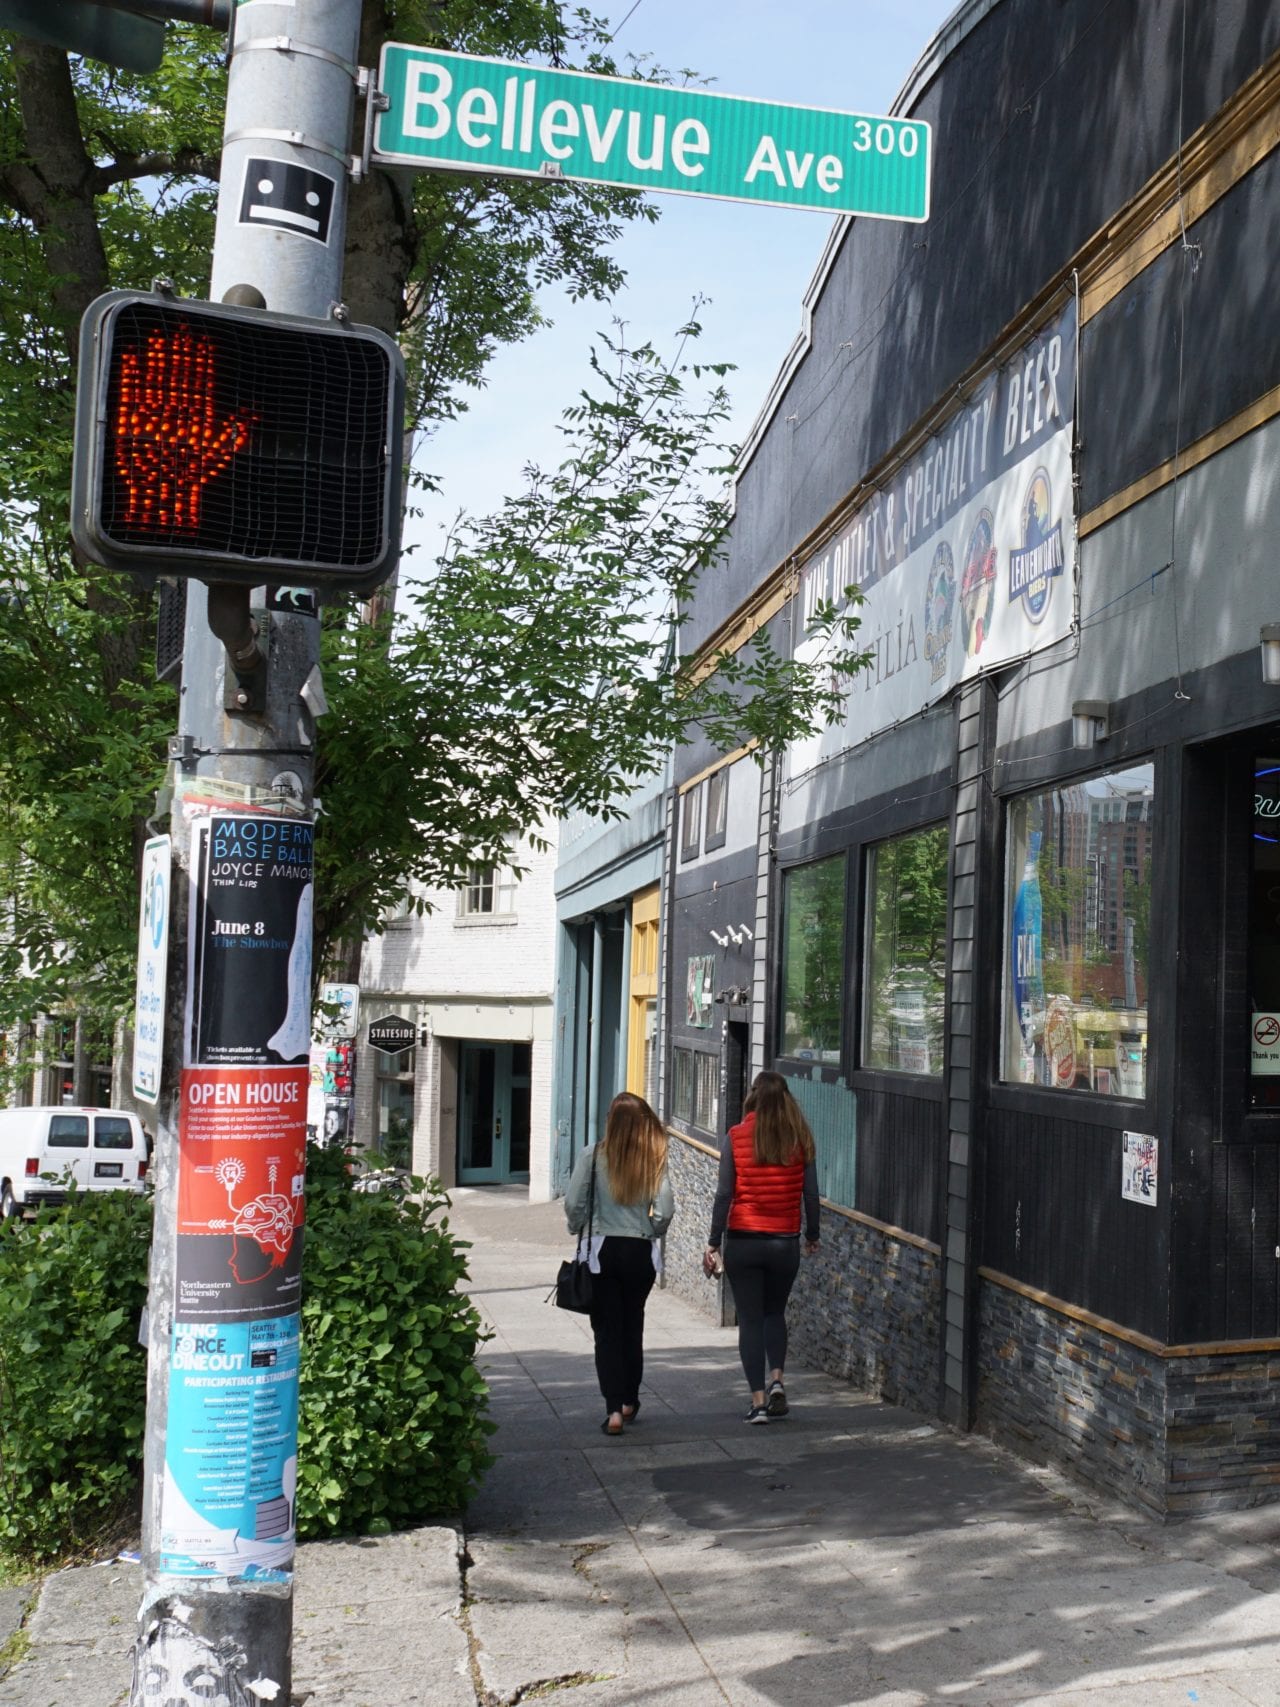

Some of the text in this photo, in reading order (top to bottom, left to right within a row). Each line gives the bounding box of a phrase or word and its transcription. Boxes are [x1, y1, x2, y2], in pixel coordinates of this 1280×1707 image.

[402, 59, 919, 193] Bellevue Ave 300
[833, 507, 882, 604] OUTLET
[883, 493, 896, 559] &
[903, 391, 995, 546] SPECIALTY
[1003, 334, 1062, 457] BEER
[1010, 526, 1063, 593] LEAVENWORTH
[215, 821, 313, 844] MODERN
[211, 862, 265, 878] JOYCE
[212, 879, 258, 888] THIN LIPS
[211, 920, 265, 936] June 8
[212, 937, 237, 948] The
[371, 1028, 414, 1038] STATESIDE
[188, 1082, 298, 1105] OPEN HOUSE
[180, 1280, 232, 1288] Northeastern
[180, 1288, 221, 1298] University
[174, 1323, 218, 1338] LUNG
[252, 1324, 276, 1332] SEATTLE
[174, 1335, 226, 1354] FORCE
[184, 1368, 297, 1388] PARTICIPATING RESTAURANTS
